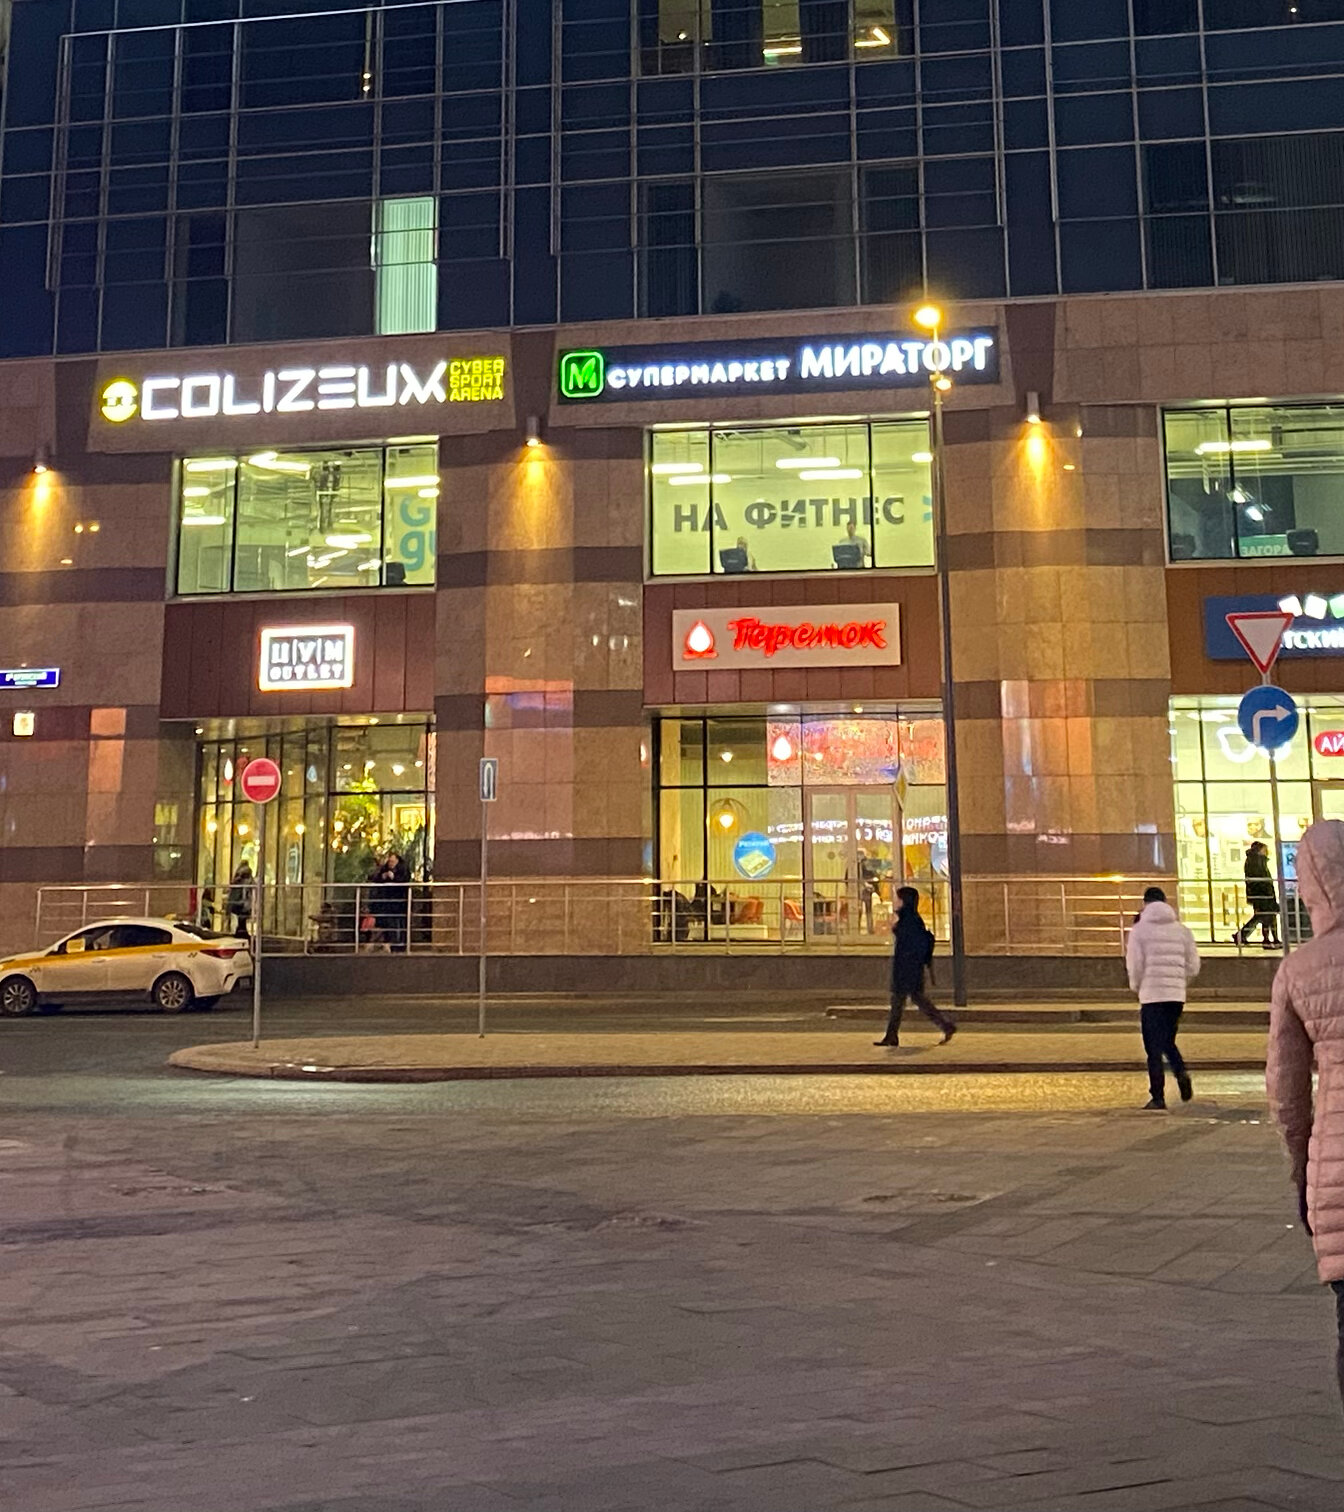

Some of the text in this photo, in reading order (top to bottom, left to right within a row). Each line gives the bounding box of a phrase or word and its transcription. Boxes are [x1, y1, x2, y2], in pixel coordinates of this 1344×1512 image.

[450, 359, 504, 375] CYBER
[607, 338, 993, 388] СУПЕРМАРКЕТ МИРАТОРГ
[449, 373, 502, 388] SPORT
[449, 386, 504, 402] ARENA
[674, 496, 905, 532] НА ФИТНЕС
[728, 617, 886, 657] Теремок
[270, 663, 344, 680] OUTLET
